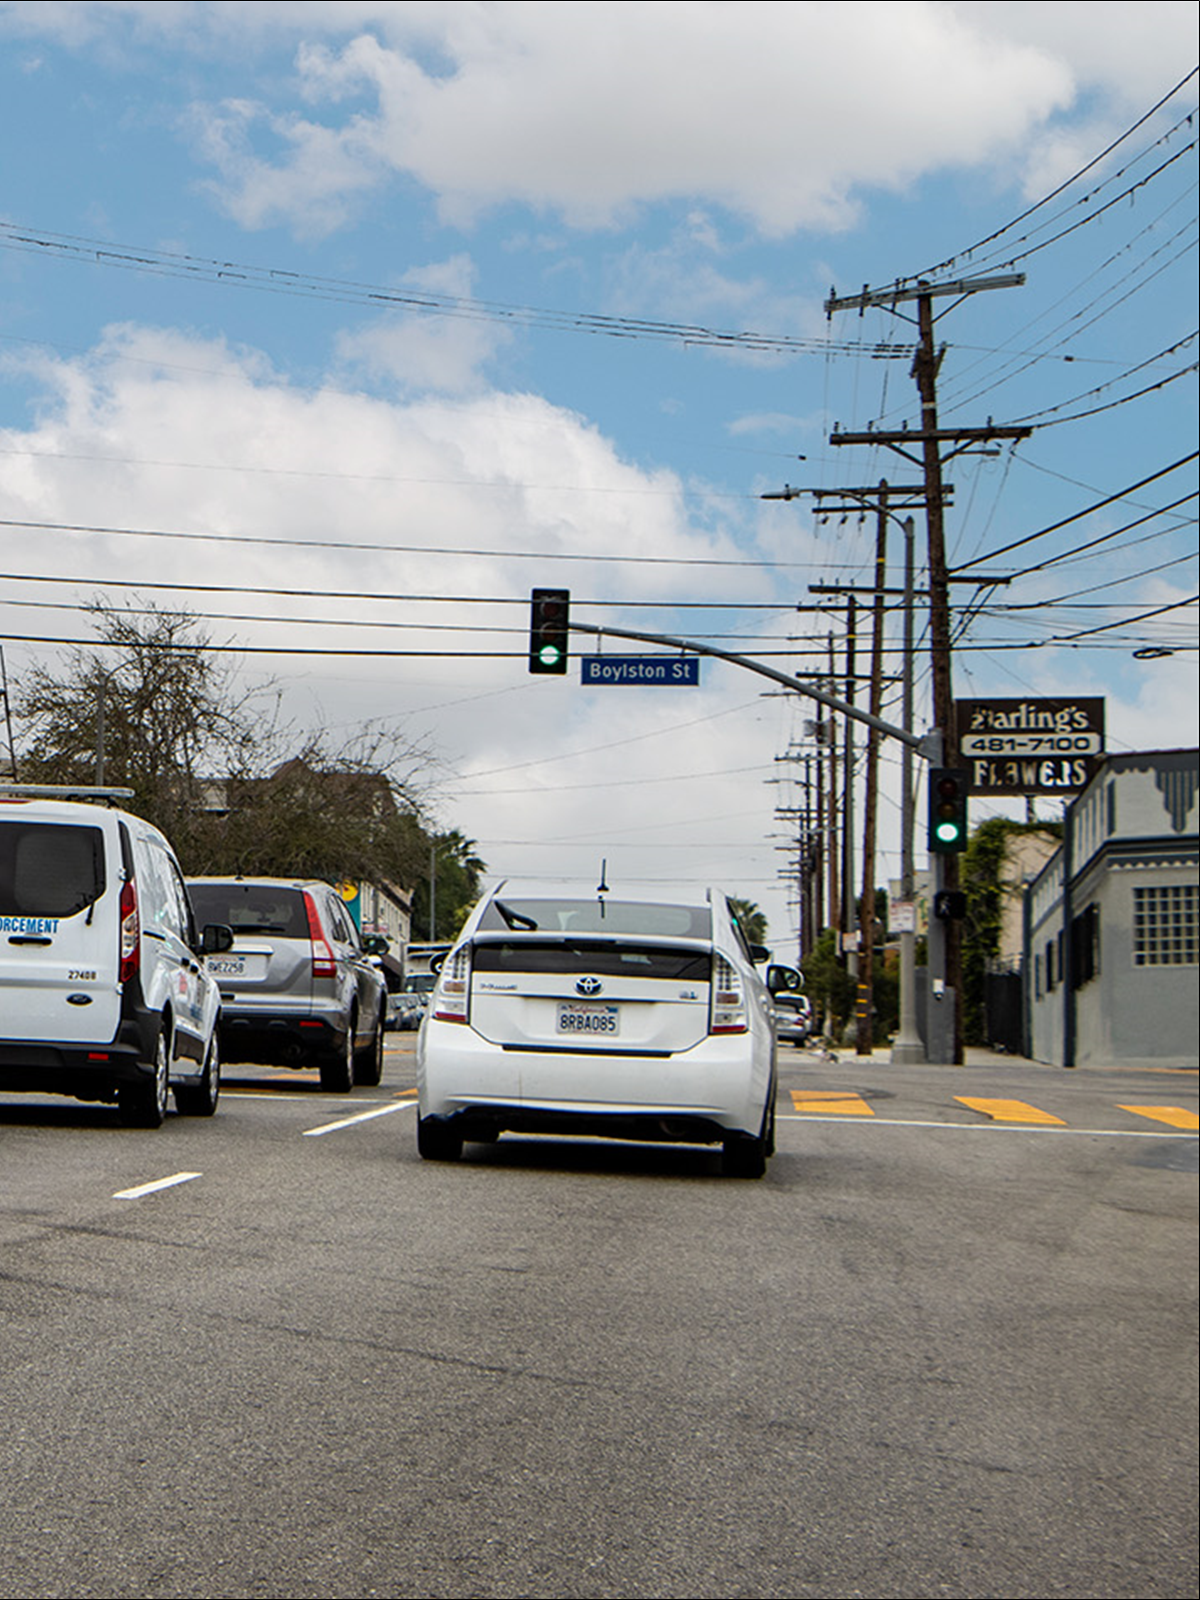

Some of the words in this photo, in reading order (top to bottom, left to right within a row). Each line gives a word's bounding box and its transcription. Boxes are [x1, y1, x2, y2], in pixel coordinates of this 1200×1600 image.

[590, 662, 666, 681] Boylston
[672, 662, 691, 679] St
[970, 737, 1091, 751] 481-7100
[560, 1013, 617, 1031] 8RBA085
